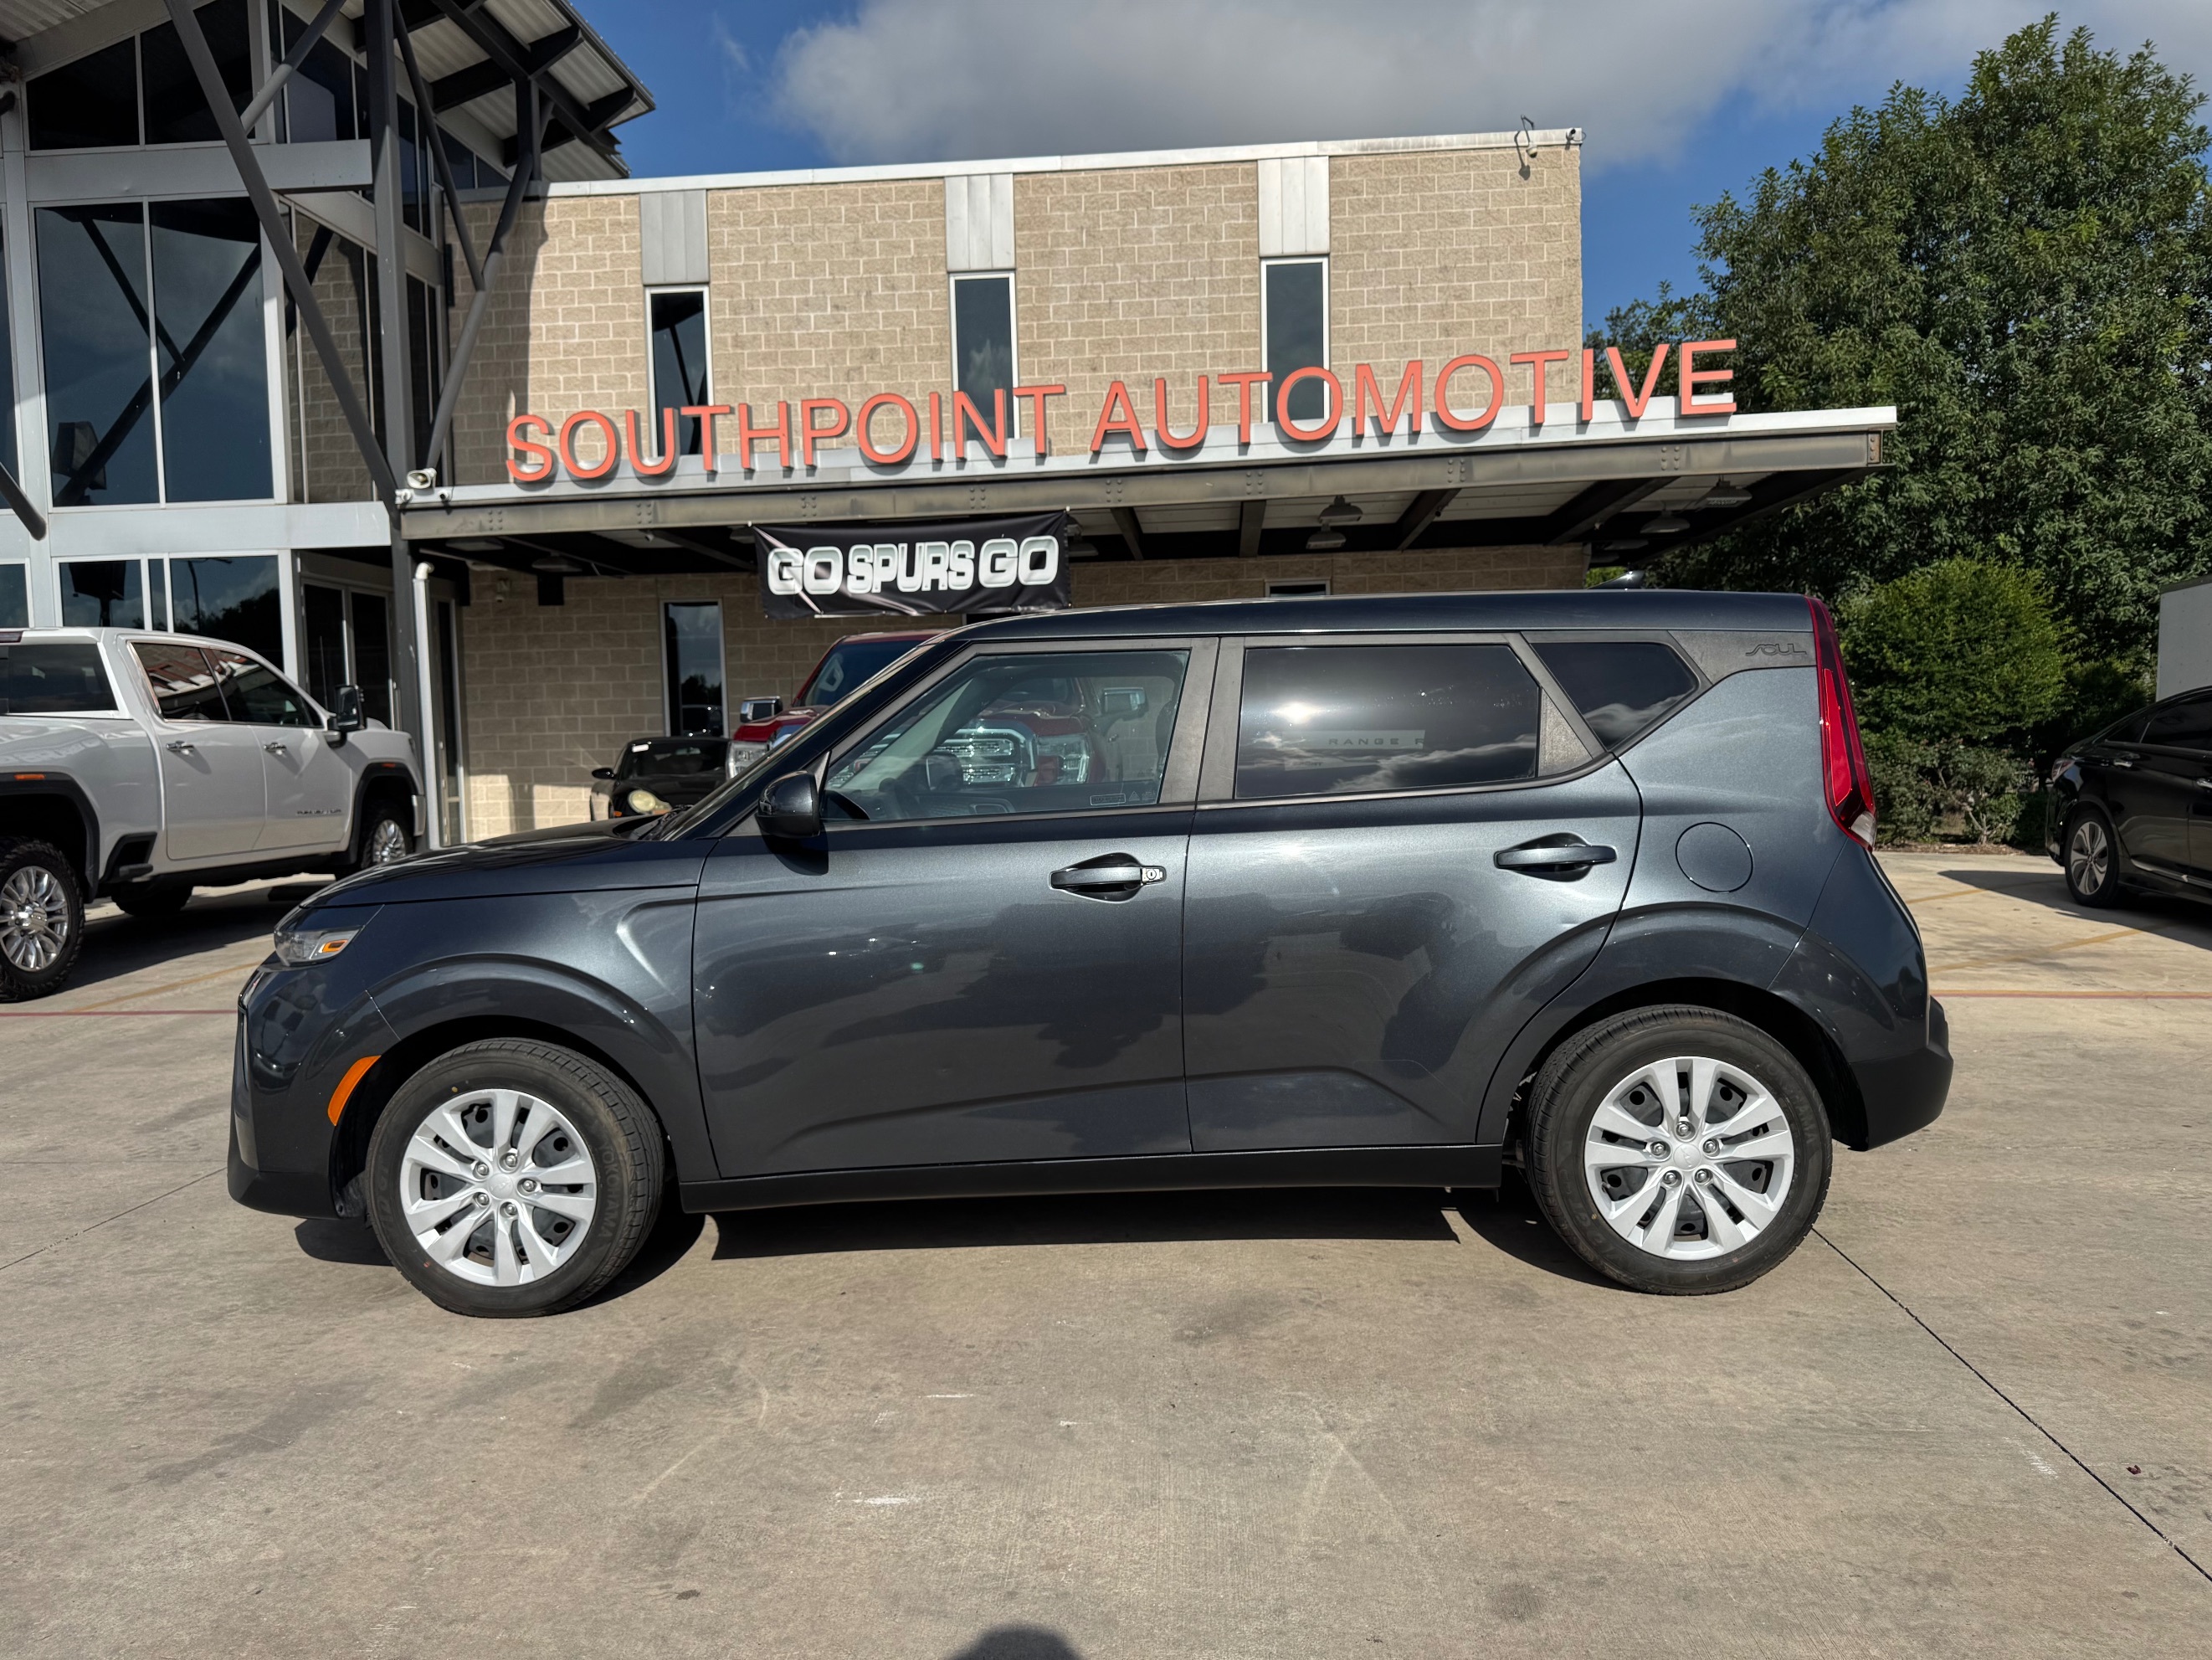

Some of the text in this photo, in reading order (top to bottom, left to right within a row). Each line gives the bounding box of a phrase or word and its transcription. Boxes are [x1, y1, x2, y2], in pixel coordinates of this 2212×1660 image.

[506, 339, 1737, 482] SOUTHPOINT AUTOMOTIVE
[767, 535, 1060, 595] GO SPURS GO
[1745, 643, 1808, 656] SOUL
[1328, 737, 1399, 746] RANGE
[598, 1138, 621, 1237] YOKOHAMA
